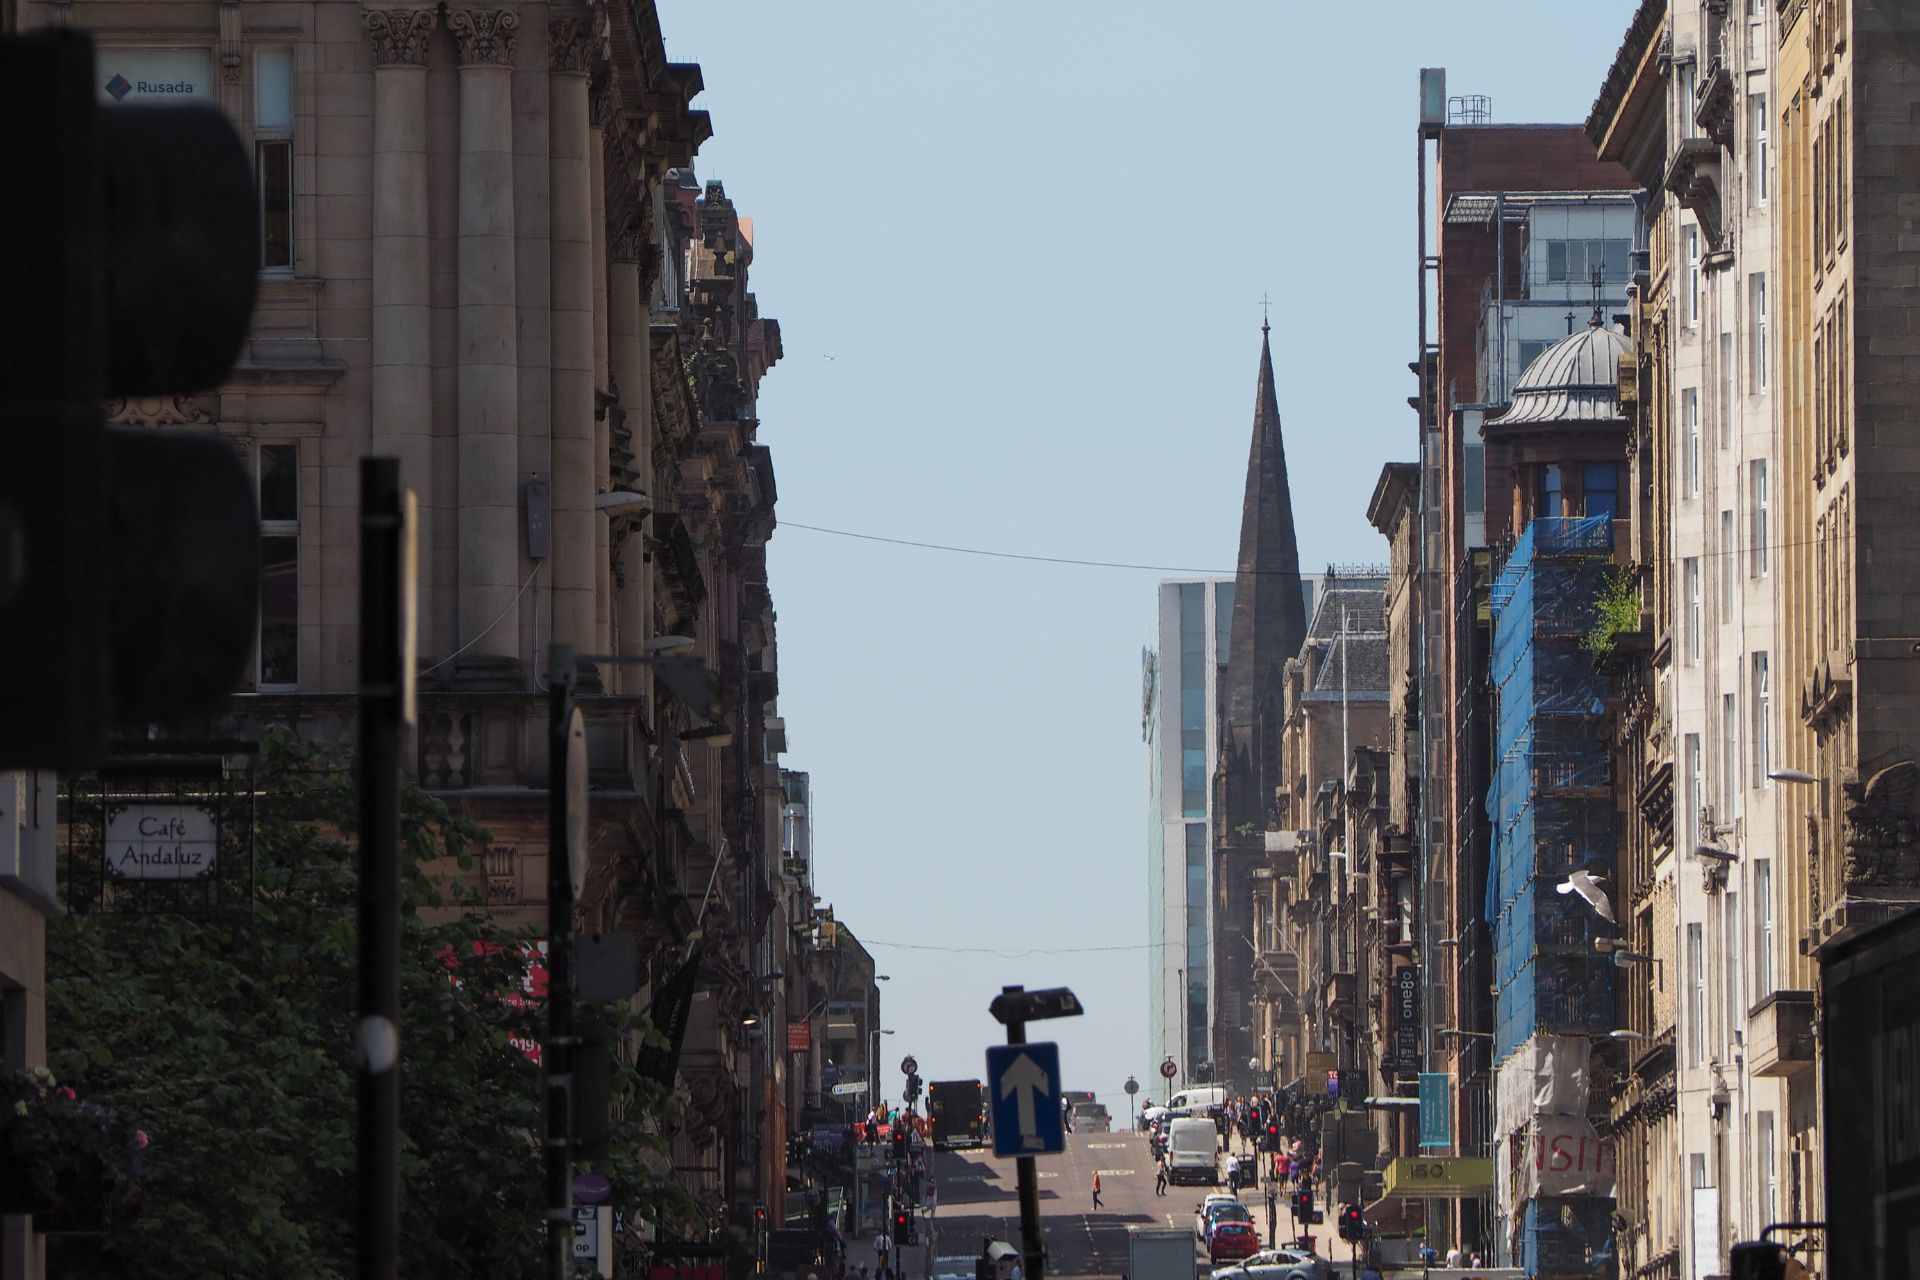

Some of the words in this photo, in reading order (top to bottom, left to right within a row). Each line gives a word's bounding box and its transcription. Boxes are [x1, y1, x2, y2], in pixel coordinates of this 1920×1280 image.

[137, 81, 194, 94] Rusada
[139, 816, 187, 840] Café
[120, 844, 202, 866] Andaluz
[575, 1244, 589, 1253] op
